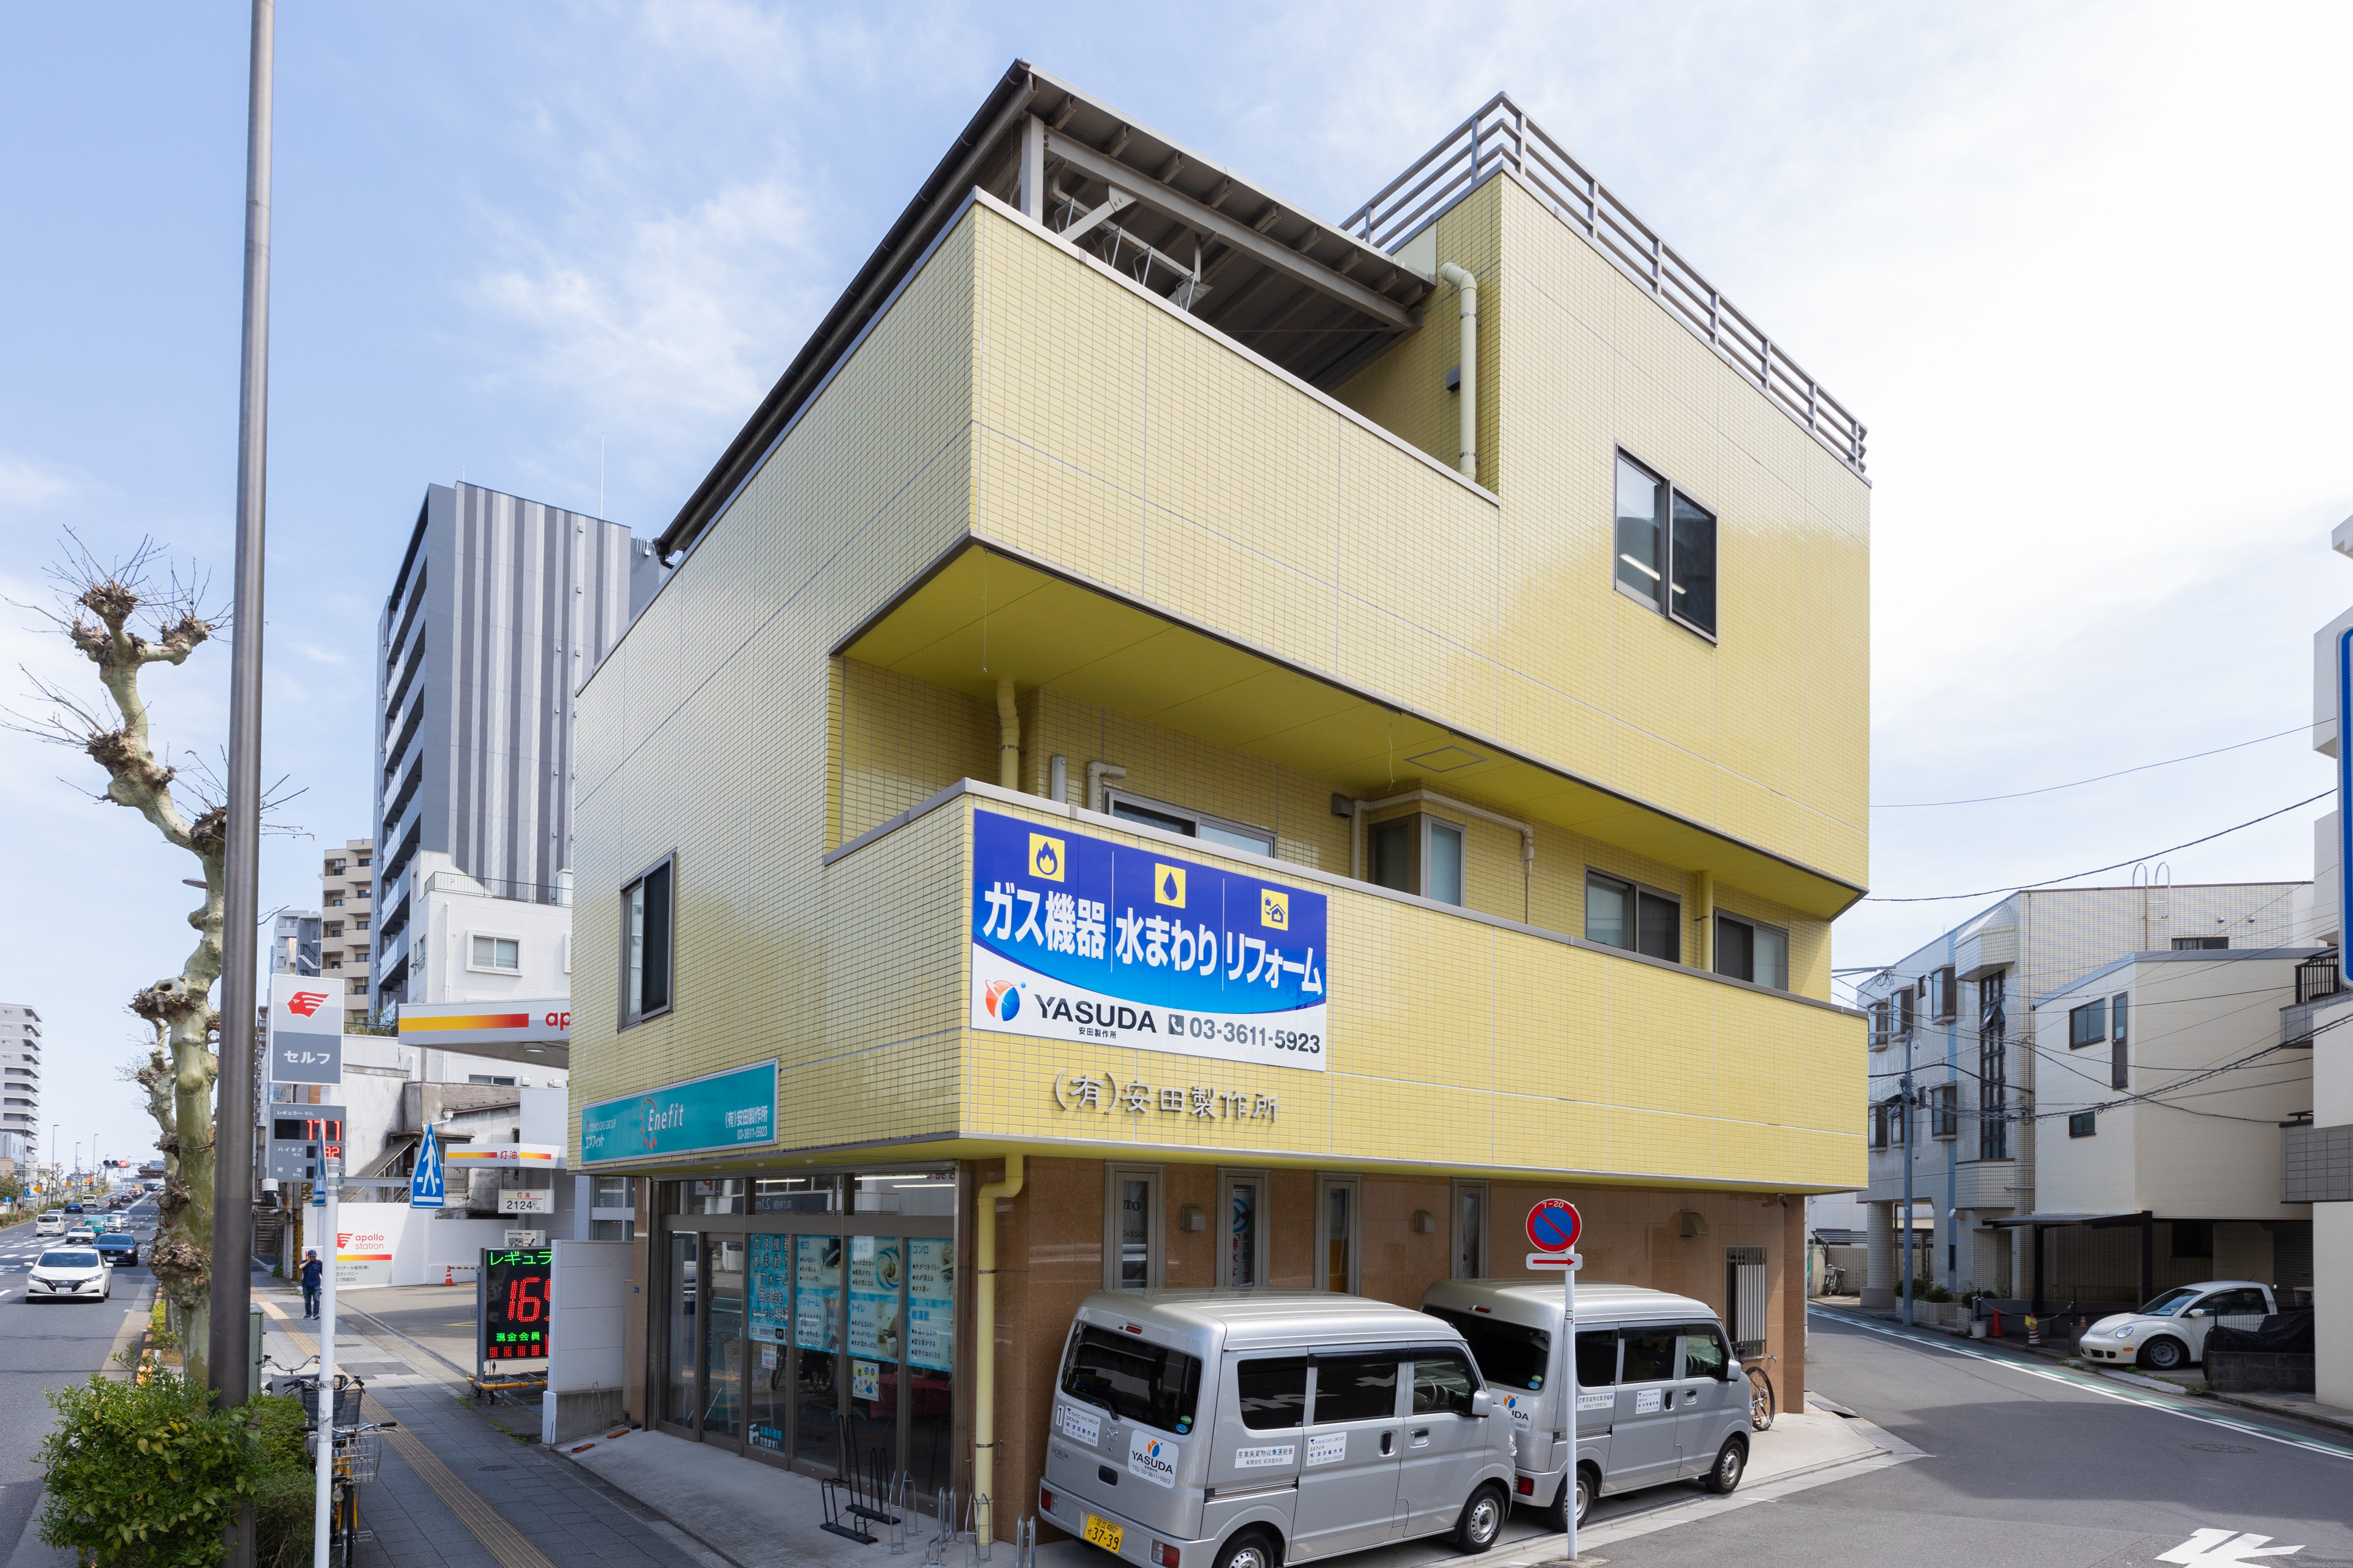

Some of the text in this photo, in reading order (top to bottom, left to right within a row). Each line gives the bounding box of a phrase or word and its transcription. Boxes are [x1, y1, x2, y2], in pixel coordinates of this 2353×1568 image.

[983, 881, 1106, 960] ガス機器
[1116, 907, 1217, 976] 水まわり
[1226, 931, 1323, 996] リフォーム
[1034, 993, 1157, 1033] YASUDA
[1078, 1026, 1117, 1039] 安田製作所
[1189, 1016, 1320, 1054] 03-3611-5923
[283, 1050, 331, 1064] セルフ
[647, 1103, 684, 1133] Enefit
[737, 1125, 768, 1141] 03-3611-5923
[585, 1133, 605, 1149] エネフィット
[500, 1150, 518, 1160] 灯油
[506, 1200, 533, 1210] 2124
[1542, 1200, 1564, 1209] 7-20
[355, 1233, 384, 1242] apollo
[913, 1245, 929, 1255] コンロ
[799, 1296, 820, 1307] リフォーム
[852, 1303, 865, 1313] トイレ
[496, 1331, 540, 1343] 現金会員
[1052, 1446, 1069, 1459] SCRUM
[1132, 1450, 1173, 1475] YASUDA
[1096, 1518, 1116, 1533] 足立 480
[1091, 1527, 1119, 1550] 37-39
